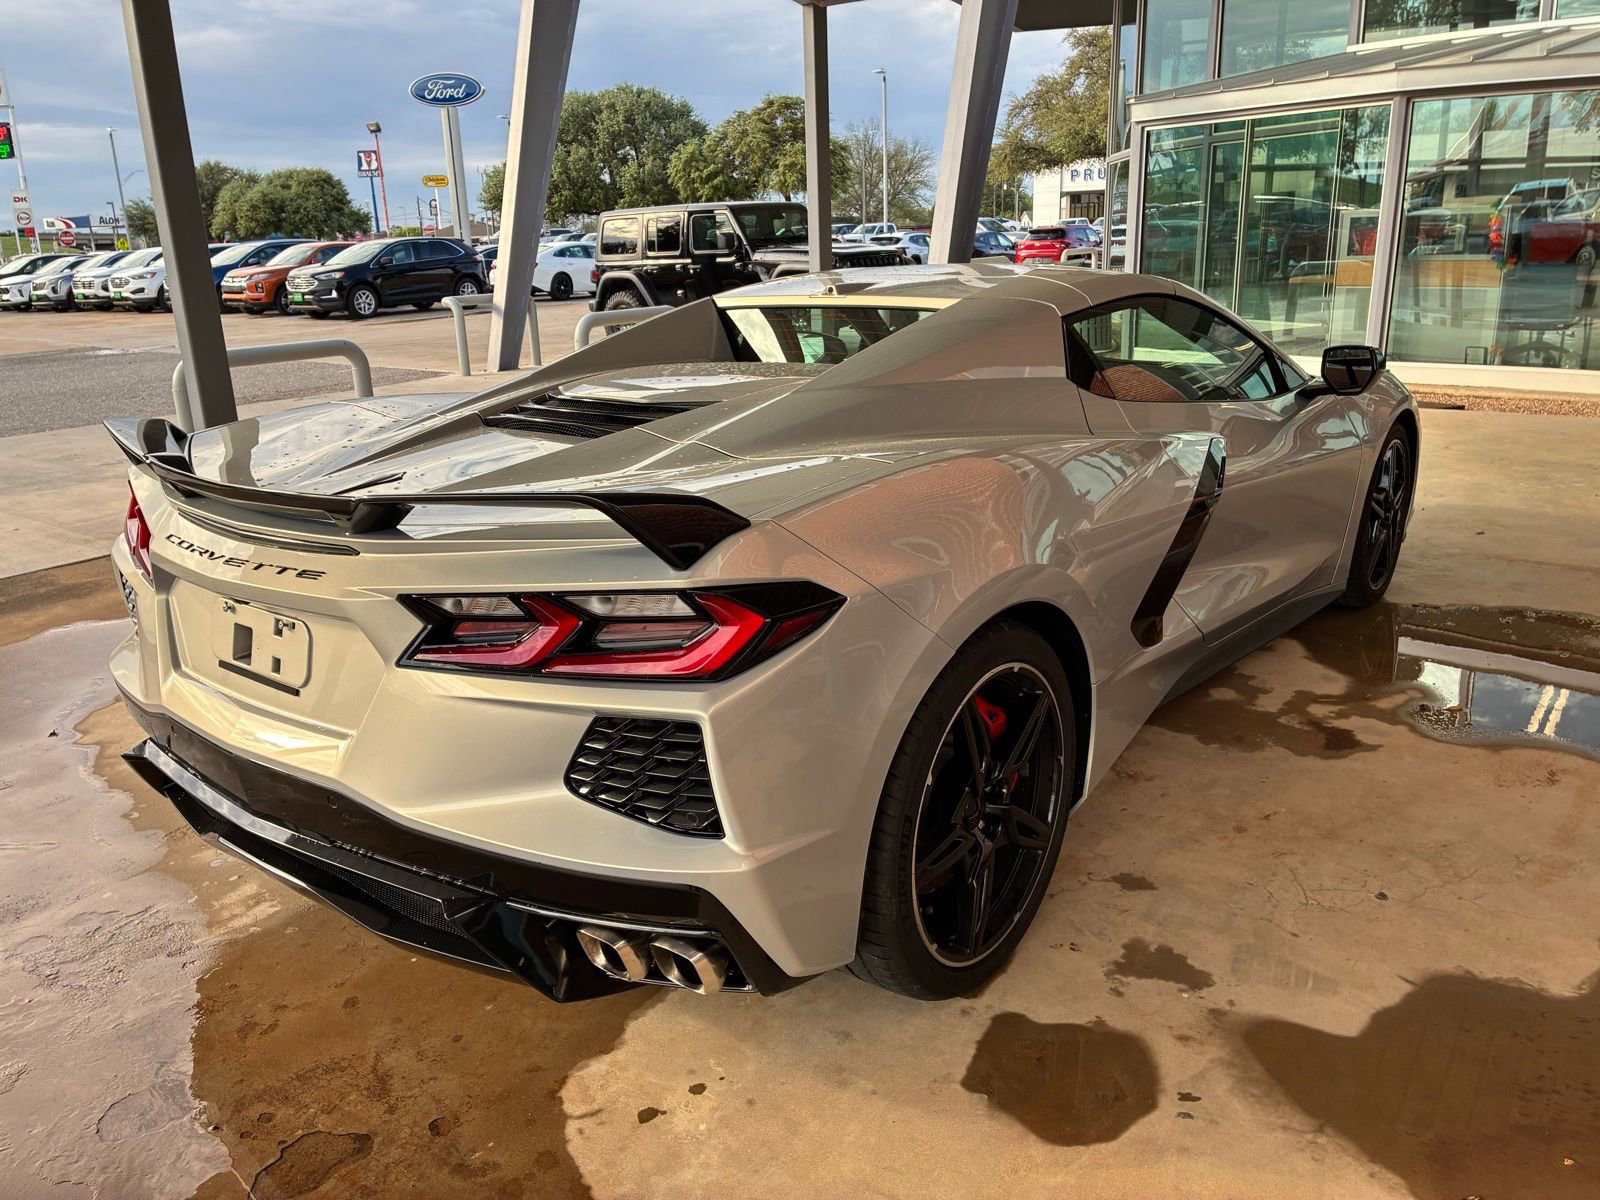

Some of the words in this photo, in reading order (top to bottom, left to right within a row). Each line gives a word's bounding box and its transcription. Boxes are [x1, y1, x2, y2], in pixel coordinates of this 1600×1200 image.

[424, 79, 466, 99] Ford
[1070, 167, 1106, 181] PRU
[164, 533, 327, 580] CORVETTE
